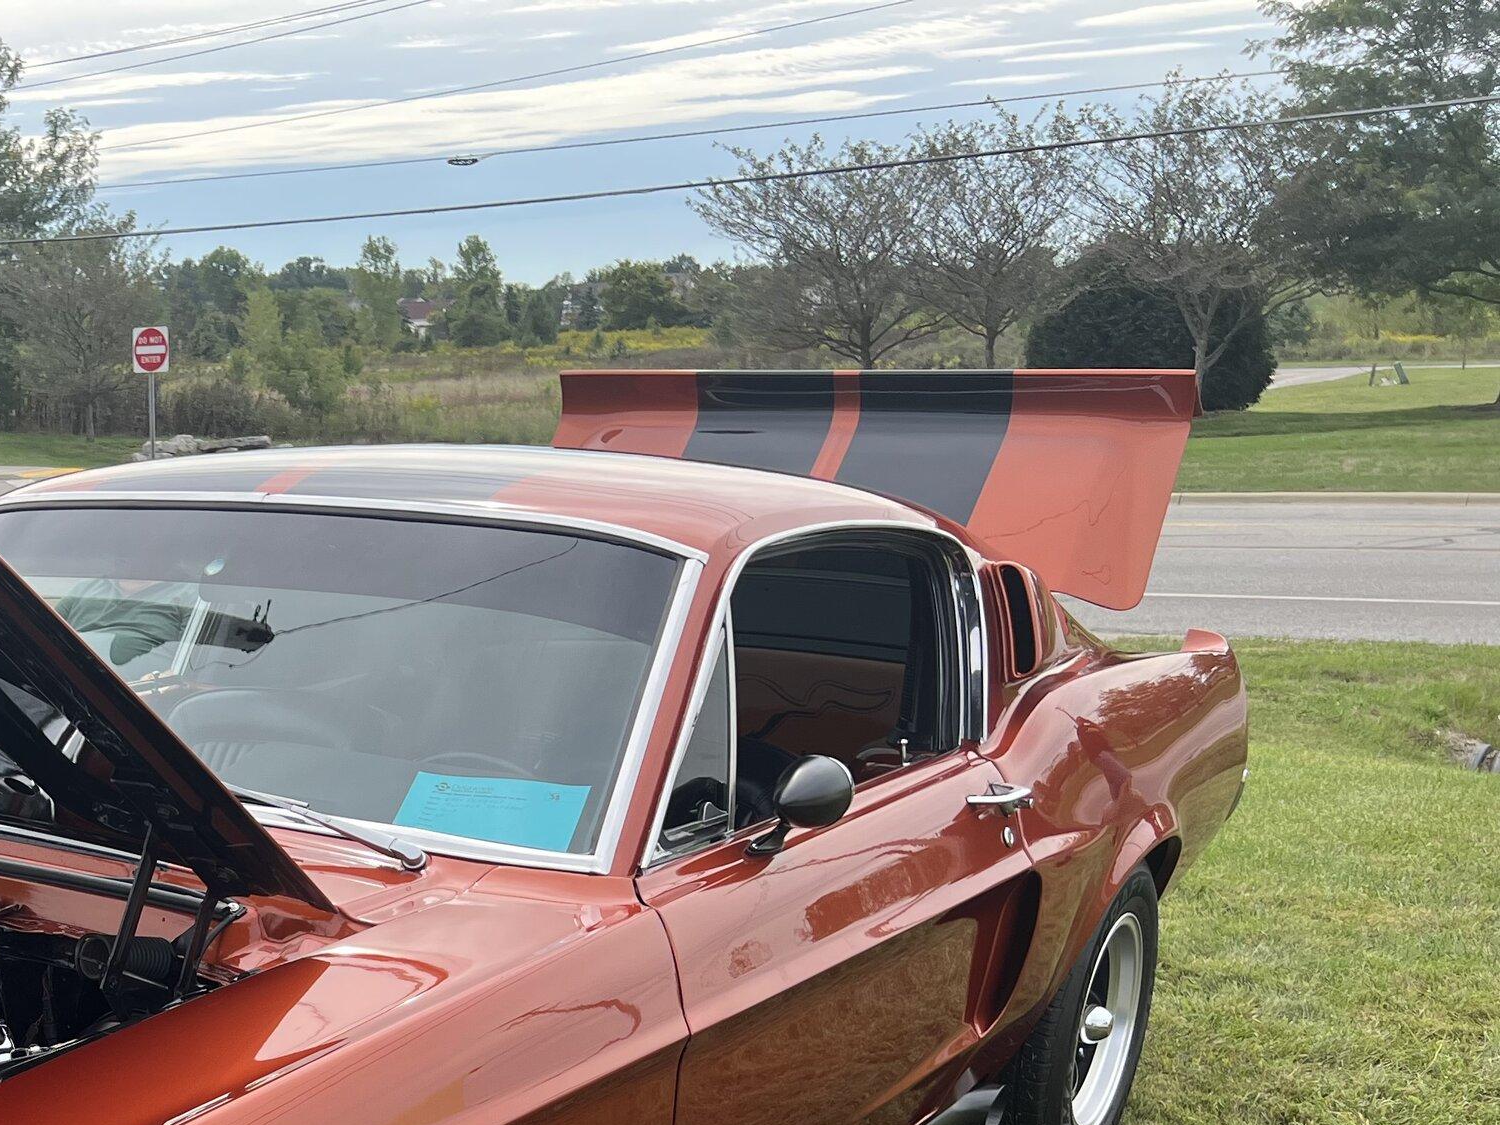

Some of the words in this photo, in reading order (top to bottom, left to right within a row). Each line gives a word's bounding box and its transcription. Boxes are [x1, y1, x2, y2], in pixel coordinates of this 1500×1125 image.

[138, 336, 148, 344] DO
[149, 335, 163, 343] NOT
[141, 355, 161, 364] ENTER
